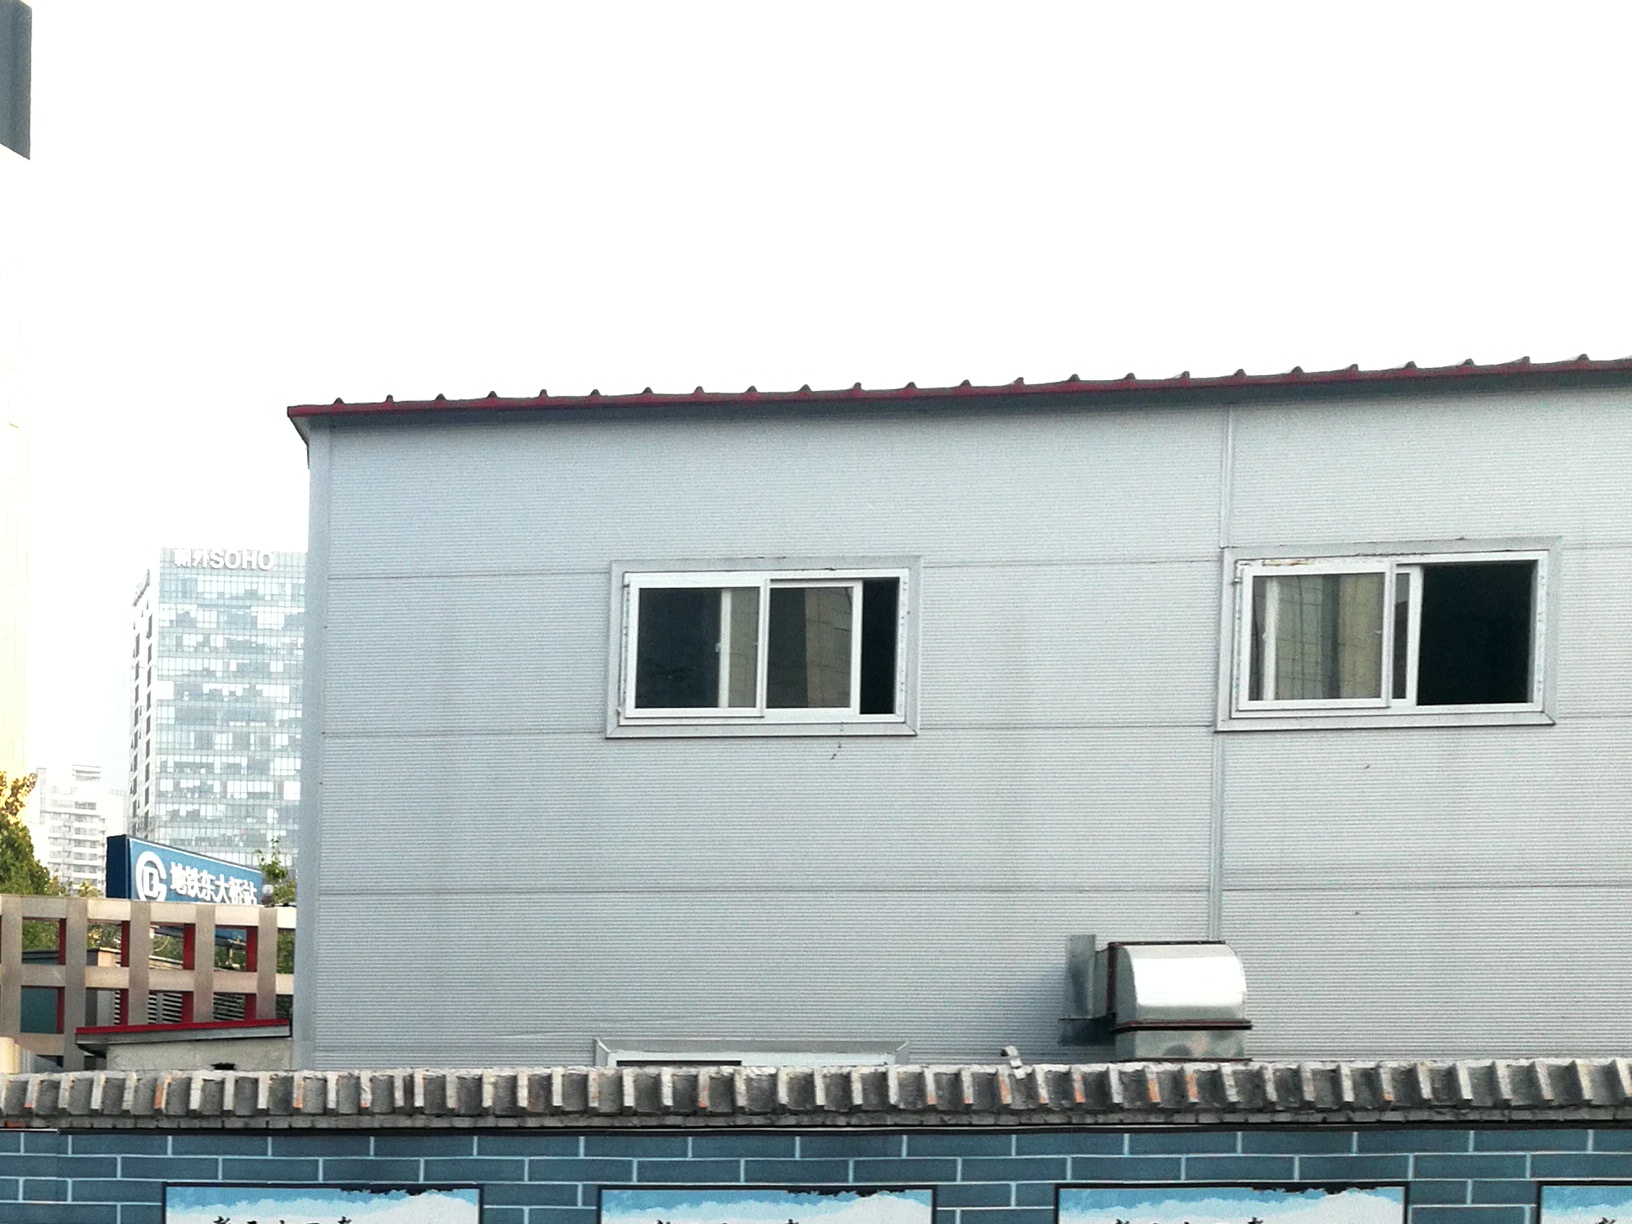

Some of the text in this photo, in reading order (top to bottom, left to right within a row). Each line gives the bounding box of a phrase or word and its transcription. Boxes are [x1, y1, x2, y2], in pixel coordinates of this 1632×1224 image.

[170, 861, 258, 905] 地铁东大桥站
